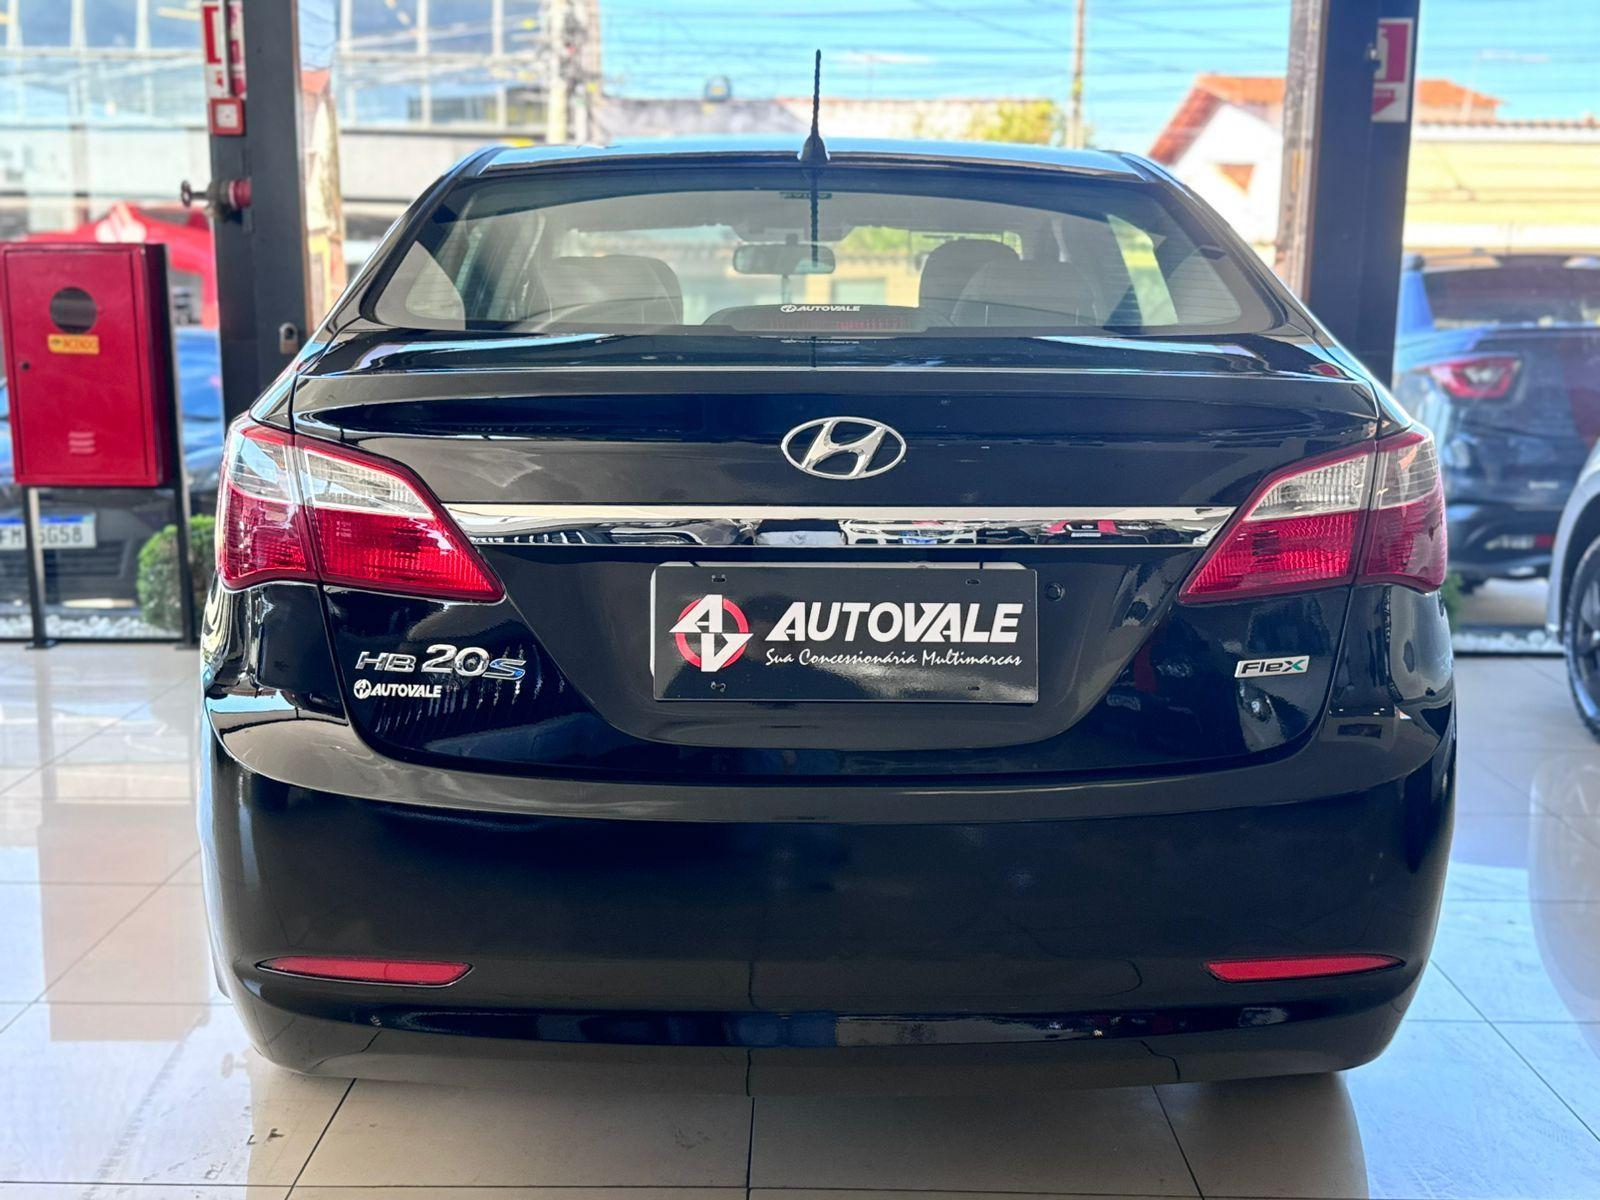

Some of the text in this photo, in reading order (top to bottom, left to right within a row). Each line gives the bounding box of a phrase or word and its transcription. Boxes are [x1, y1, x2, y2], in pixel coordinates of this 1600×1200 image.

[765, 601, 1024, 643] AUTOVALE
[765, 647, 1022, 666] Sua Concessionária Multimarcas
[370, 683, 443, 698] AUTOVALE
